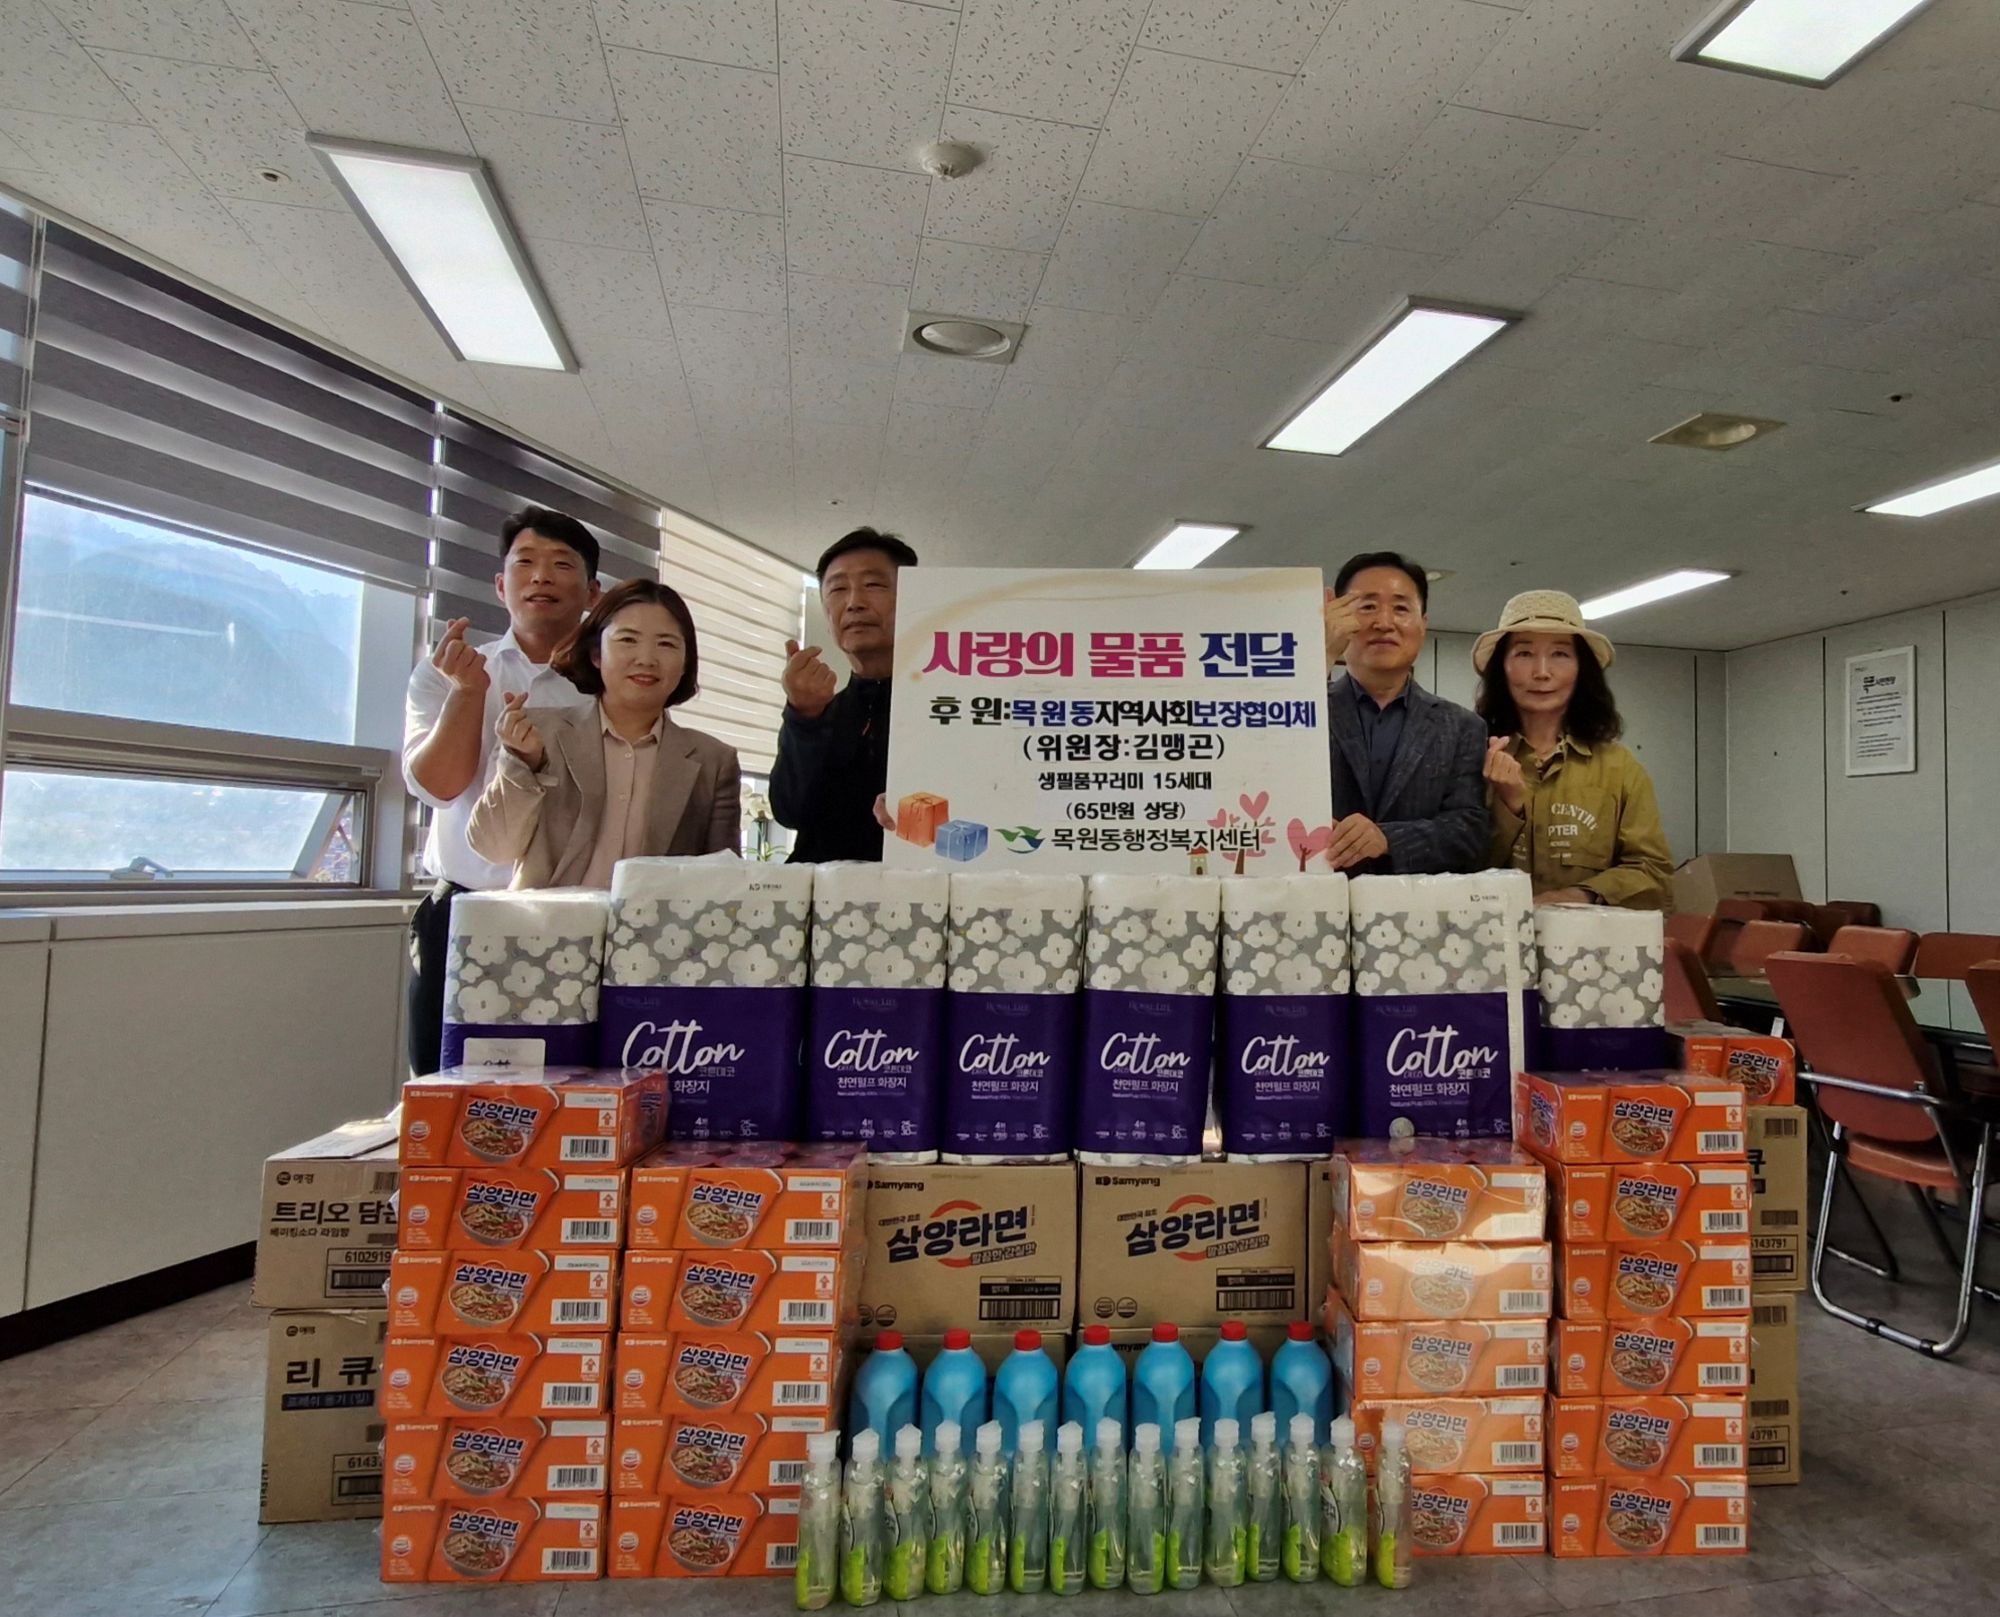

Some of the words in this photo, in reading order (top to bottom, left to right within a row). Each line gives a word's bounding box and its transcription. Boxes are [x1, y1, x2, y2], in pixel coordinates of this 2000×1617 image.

[922, 631, 1074, 678] 사랑의
[1088, 632, 1186, 678] 물품
[1199, 632, 1298, 678] 전달
[1038, 772, 1144, 791] 생필품꾸러미
[1153, 772, 1212, 791] 15세대
[1066, 802, 1135, 821] (65만원
[1144, 802, 1186, 821] 상당)
[1052, 827, 1260, 852] 목원동행정복지센터
[622, 1019, 744, 1075] Cotton
[824, 1028, 919, 1071] Cotton
[959, 1033, 1051, 1075] Cotton
[1101, 1032, 1191, 1074] Cotton
[1241, 1034, 1330, 1076] Cotton
[1386, 1024, 1498, 1078] Cotton
[674, 1080, 710, 1094] 화장지
[878, 1077, 907, 1088] 화장지
[1011, 1081, 1039, 1092] 화장지
[1151, 1080, 1178, 1092] 화장지
[1293, 1081, 1320, 1092] 화장지
[1436, 1083, 1470, 1096] 화장지
[467, 1100, 538, 1125] 삼양라면
[1614, 1101, 1674, 1123] 삼양라면
[875, 1181, 924, 1191] Samyang
[1112, 1176, 1160, 1187] Samyang
[1405, 1180, 1469, 1204] 삼양라면
[1618, 1179, 1677, 1201] 삼양라면
[466, 1184, 538, 1208] 삼양라면
[692, 1184, 763, 1208] 삼양라면
[271, 1200, 350, 1225] 트리오
[887, 1206, 1028, 1263] 삼양라면
[1125, 1199, 1260, 1257] 삼양라면
[345, 1251, 392, 1263] 6102919
[1617, 1254, 1679, 1277] 삼양라면
[454, 1264, 528, 1289] 삼양라면
[685, 1265, 756, 1289] 삼양라면
[1409, 1334, 1473, 1357] 삼양라면
[1613, 1332, 1676, 1355] 삼양라면
[447, 1346, 520, 1373] 삼양라면
[679, 1347, 749, 1370] 삼양라면
[1404, 1408, 1468, 1434] 삼양라면
[1607, 1410, 1672, 1435] 삼양라면
[451, 1431, 526, 1456] 삼양라면
[677, 1427, 746, 1450] 삼양라면
[1609, 1490, 1672, 1516] 삼양라면
[448, 1511, 519, 1538] 삼양라면
[673, 1509, 743, 1533] 삼양라면
